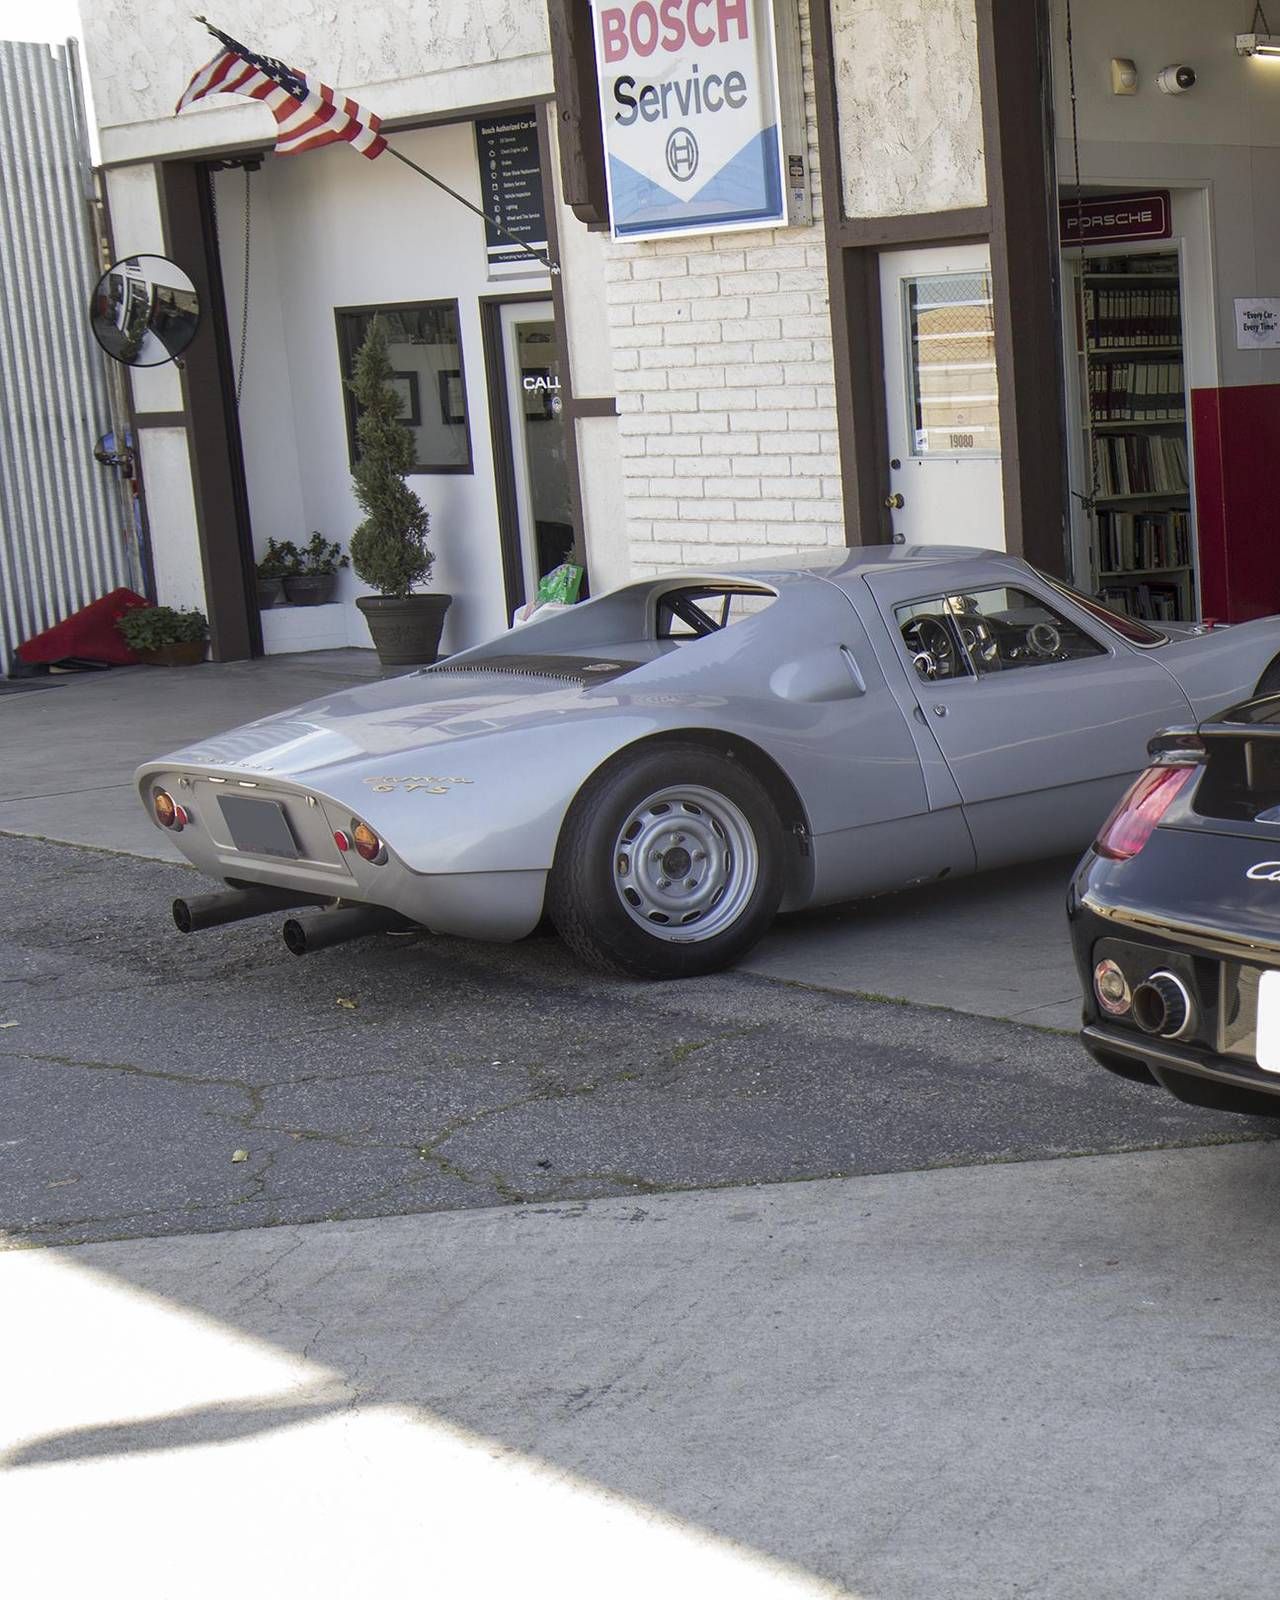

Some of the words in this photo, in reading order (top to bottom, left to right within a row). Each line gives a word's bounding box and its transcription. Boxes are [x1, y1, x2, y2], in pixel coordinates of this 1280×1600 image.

[601, 0, 749, 63] BOSCH
[614, 64, 748, 126] Service
[1067, 210, 1153, 229] PORSCHE
[1263, 310, 1273, 319] Car
[1243, 322, 1260, 333] Every
[523, 376, 561, 390] CALL
[949, 433, 974, 448] 19080
